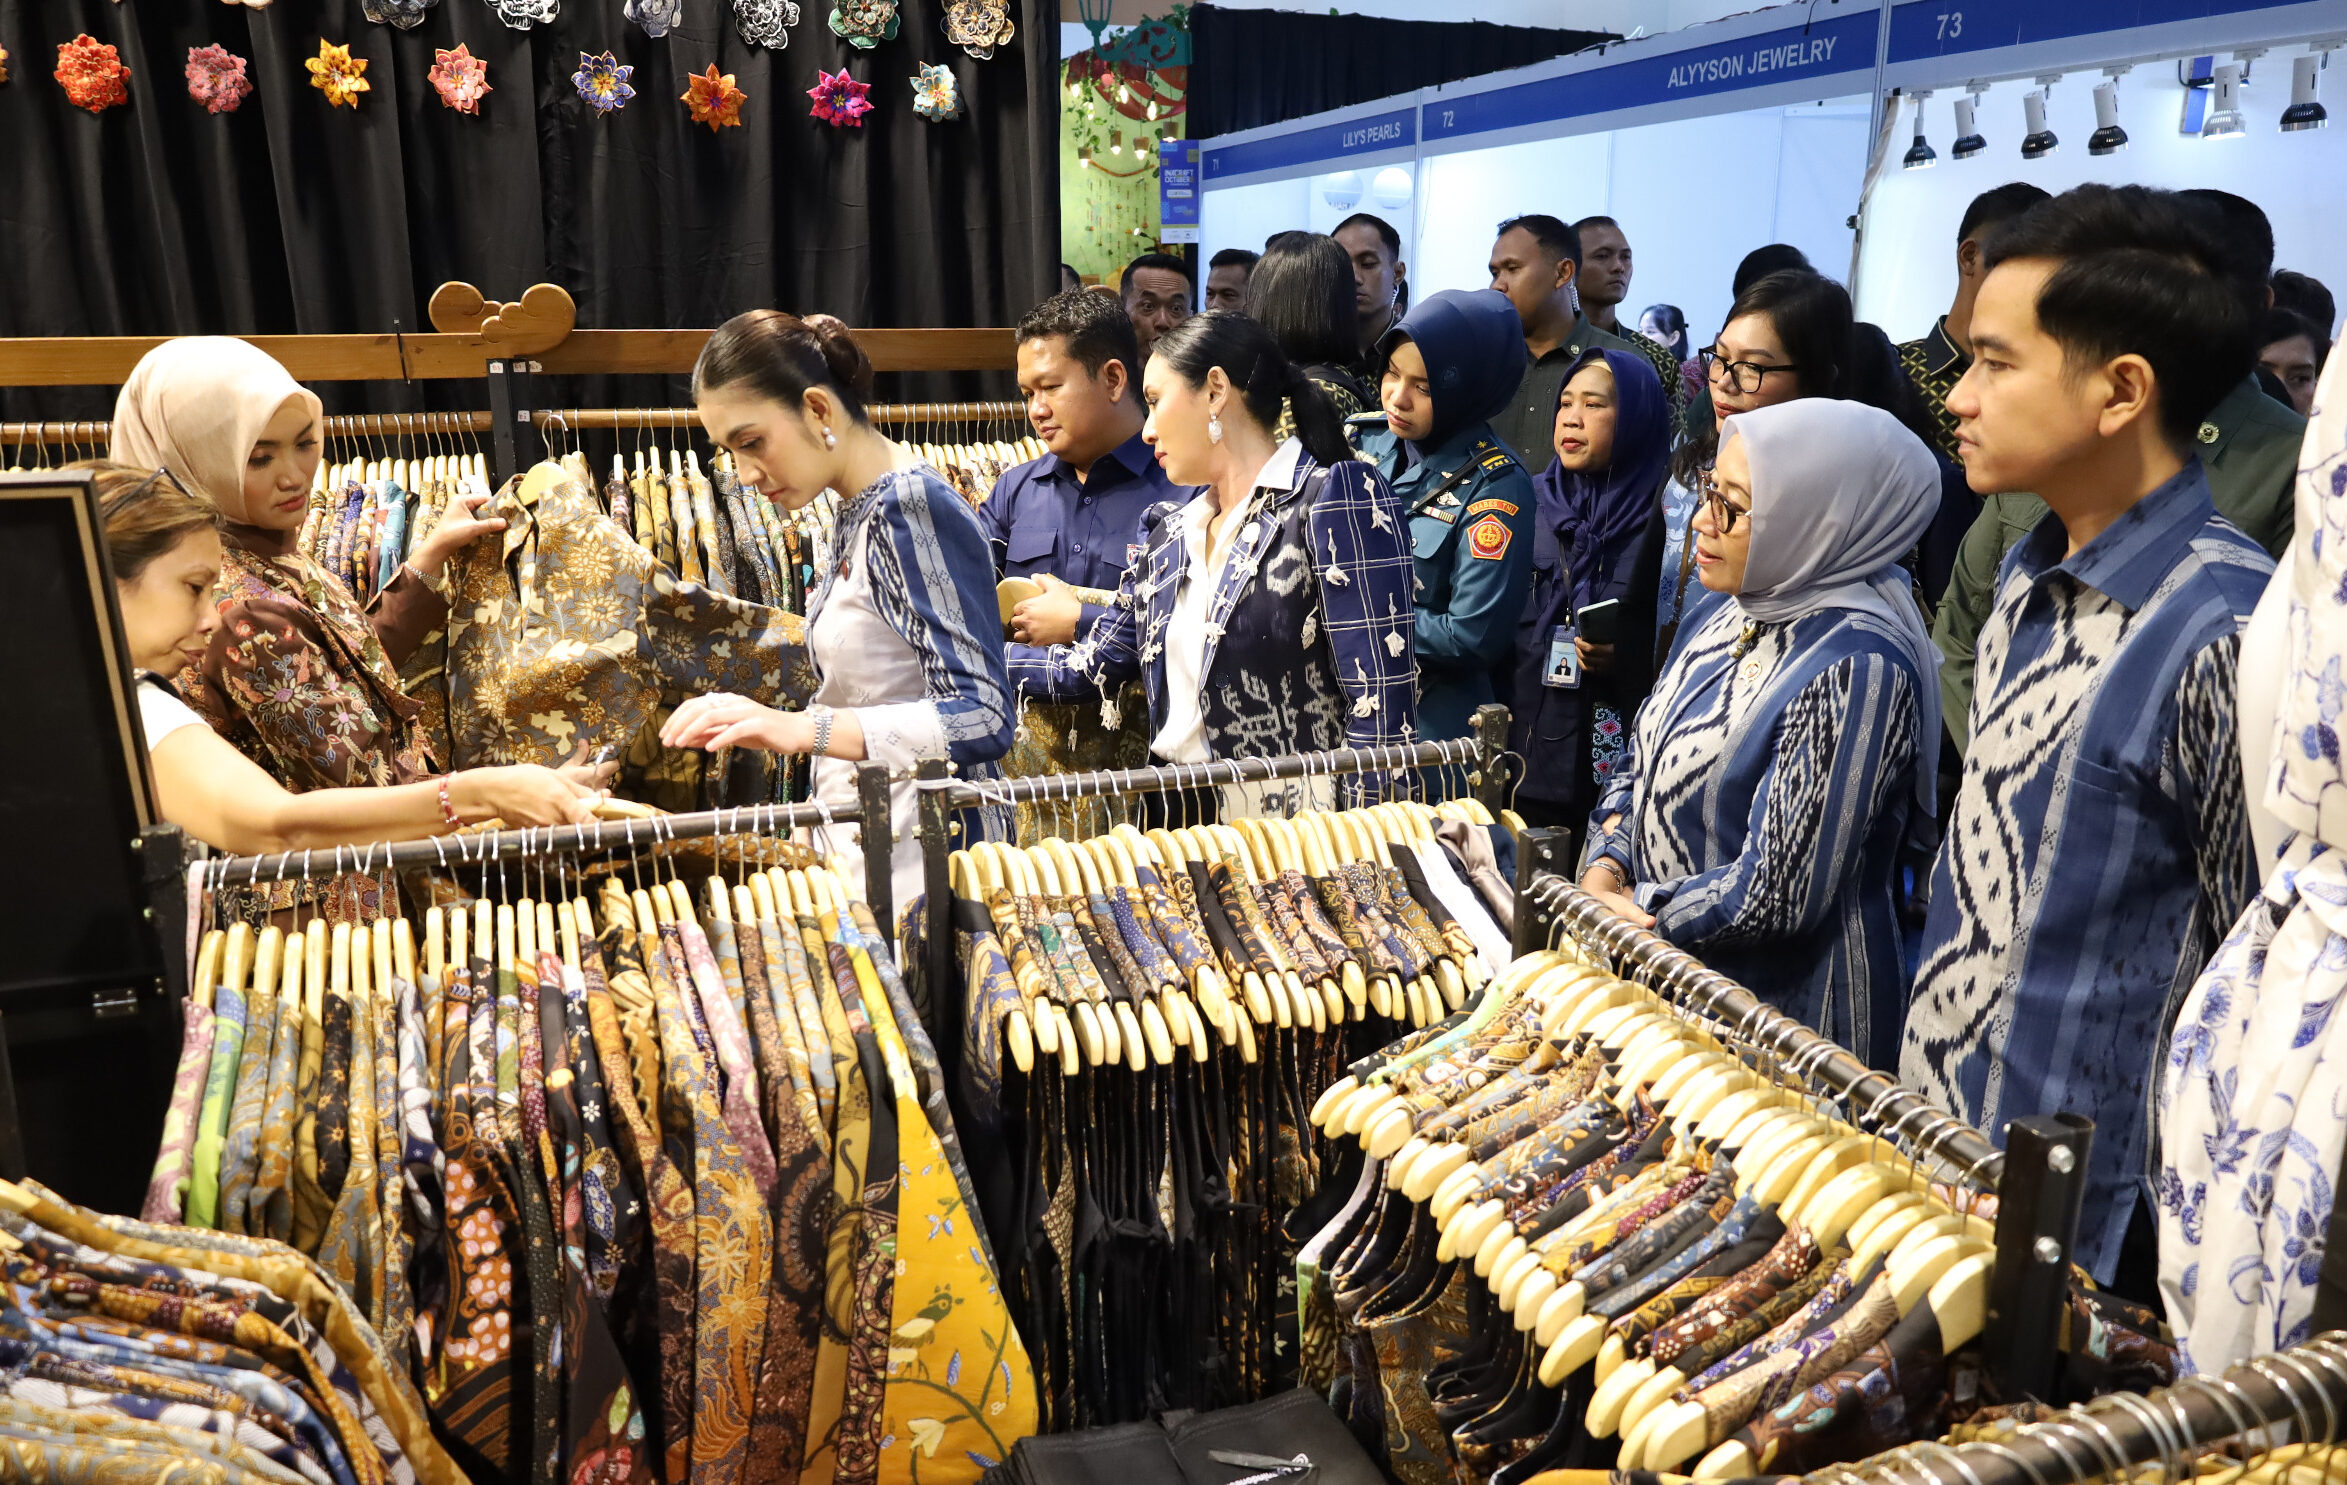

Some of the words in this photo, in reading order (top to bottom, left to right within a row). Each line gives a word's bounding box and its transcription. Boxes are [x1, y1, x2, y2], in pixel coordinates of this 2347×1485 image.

[1936, 11, 1963, 41] 73
[1667, 54, 1743, 89] ALYYSON
[1747, 36, 1837, 74] JEWELRY
[1442, 110, 1454, 128] 72
[1343, 128, 1366, 148] LILY'S
[1367, 121, 1401, 143] PEARLS
[1212, 158, 1219, 171] 71
[1486, 458, 1509, 470] TNI
[1472, 501, 1498, 511] MABES
[1502, 502, 1514, 512] TNI
